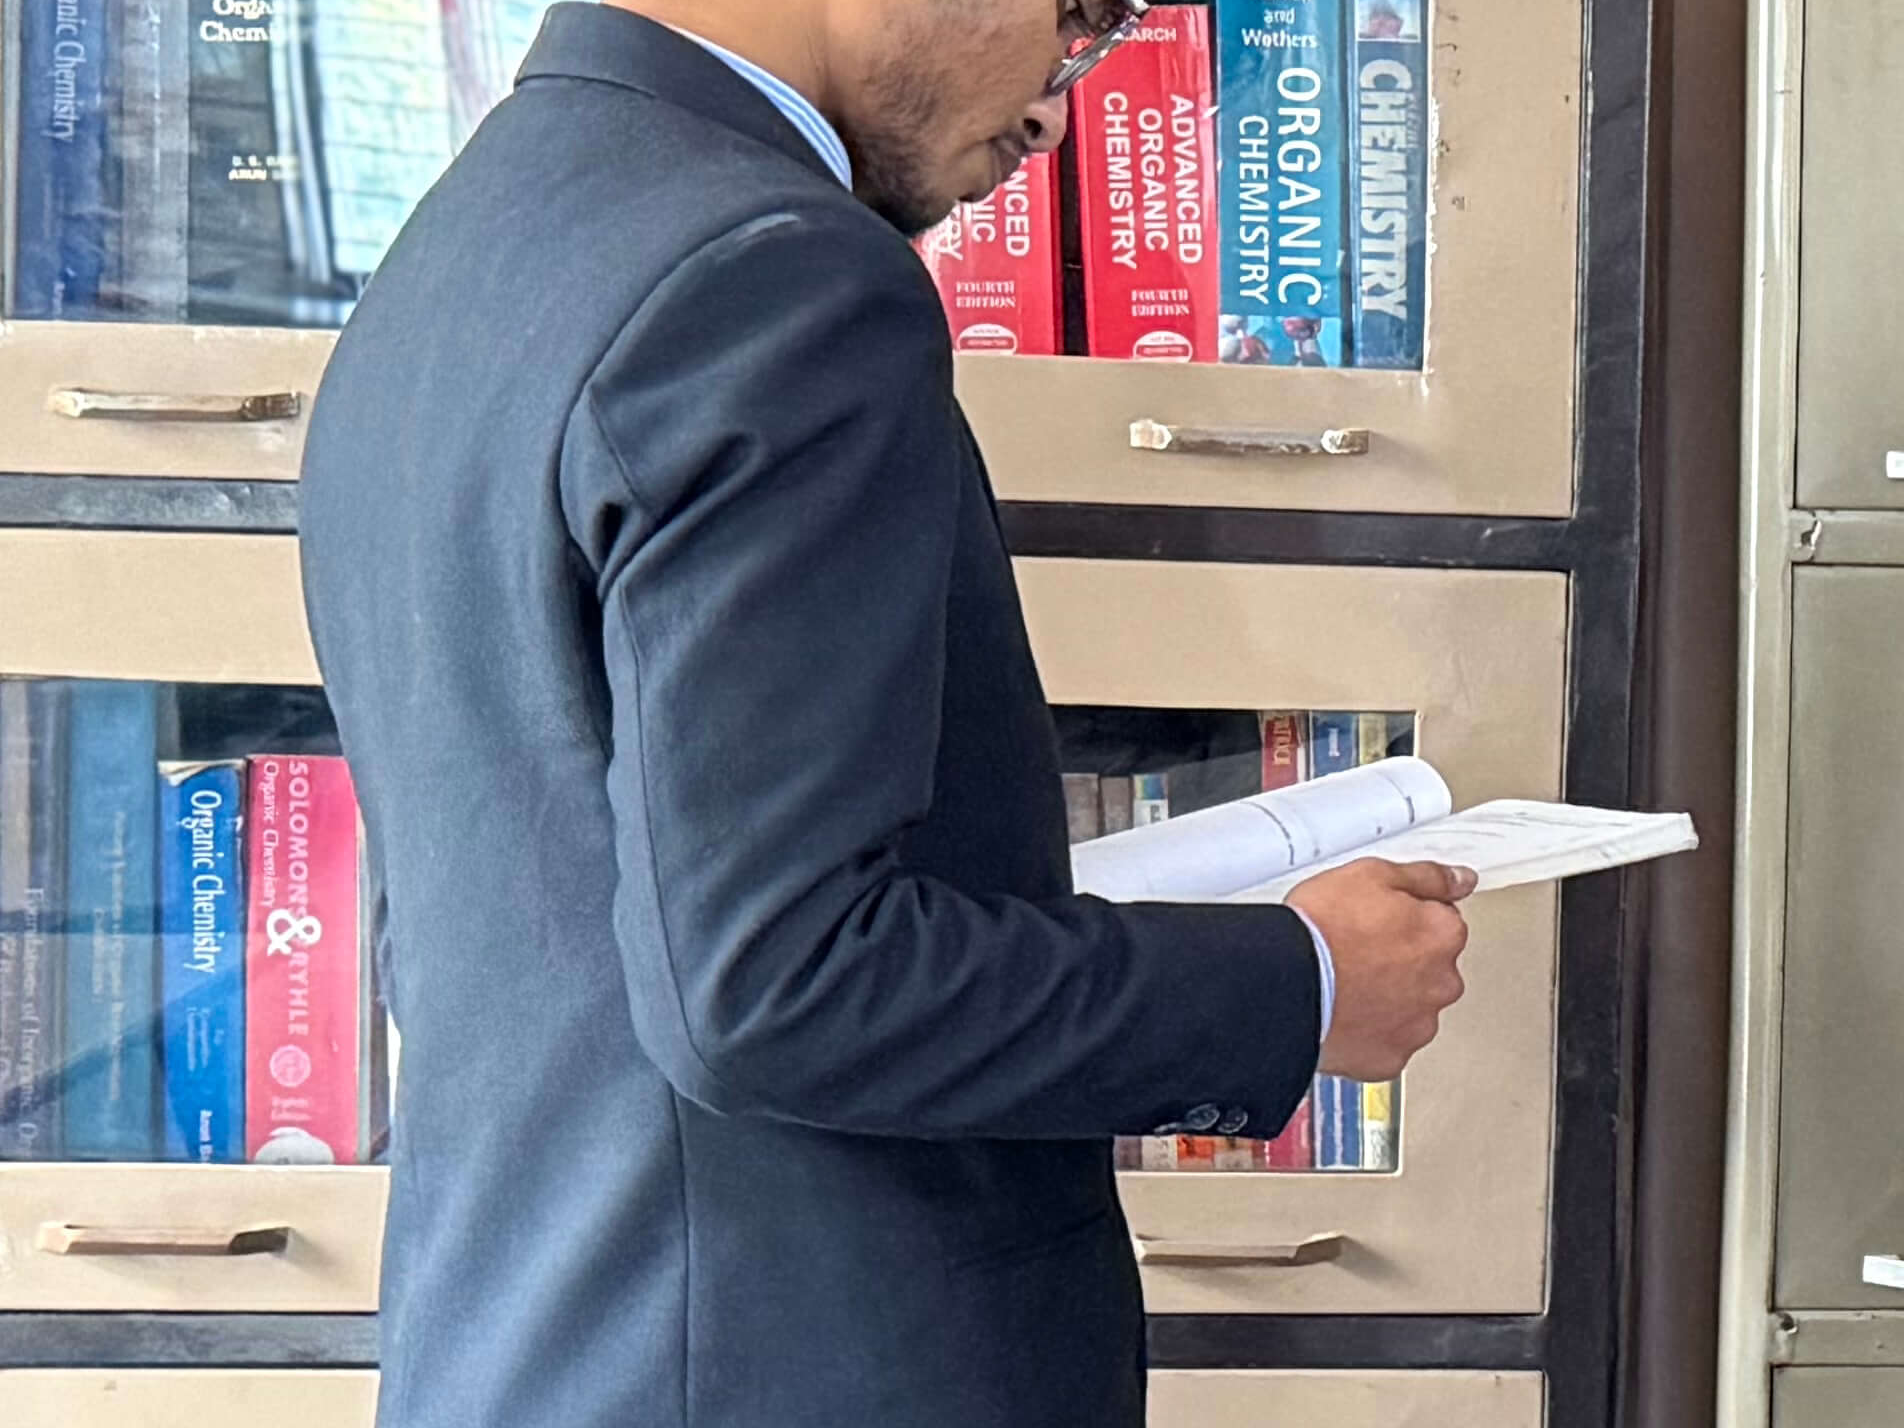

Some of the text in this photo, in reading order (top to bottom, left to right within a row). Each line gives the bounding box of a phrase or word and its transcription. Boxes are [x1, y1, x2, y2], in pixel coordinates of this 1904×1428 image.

[49, 33, 89, 143] Chemistry
[1241, 28, 1317, 49] Wothers
[1103, 92, 1138, 270] CHEMISTRY
[1137, 107, 1169, 252] ORGANIC
[1169, 93, 1203, 265] ADVANCED
[1238, 115, 1270, 305] CHEMISTRY
[1277, 67, 1322, 306] ORGANIC
[1359, 59, 1413, 321] CHEMISTRY
[176, 789, 221, 870] Organic
[258, 761, 281, 825] Organic
[183, 873, 226, 975] Chemistry
[266, 908, 322, 956] &
